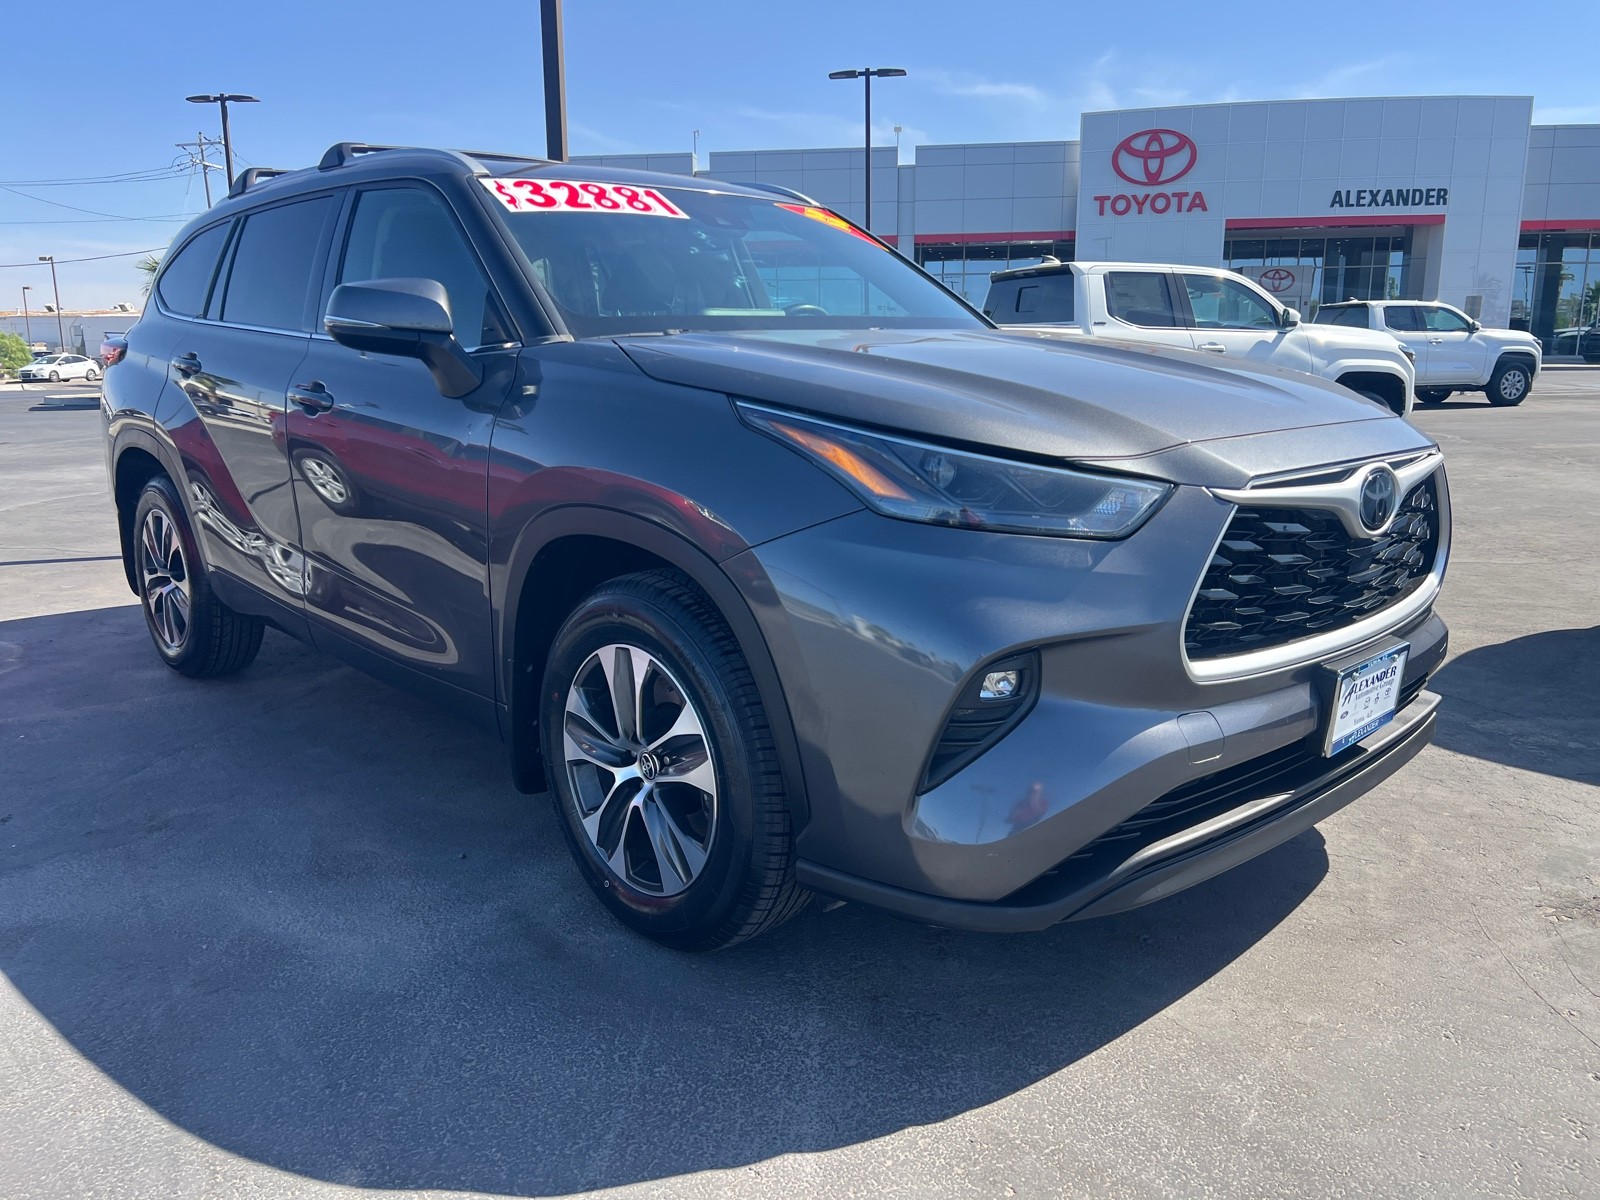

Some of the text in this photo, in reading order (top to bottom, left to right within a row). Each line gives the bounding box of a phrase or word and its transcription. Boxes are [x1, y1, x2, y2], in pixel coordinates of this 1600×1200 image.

[495, 179, 680, 216] $32881
[1094, 191, 1208, 216] TOYOTA
[1330, 188, 1448, 208] ALEXANDER
[1342, 666, 1397, 707] ALEXANDER
